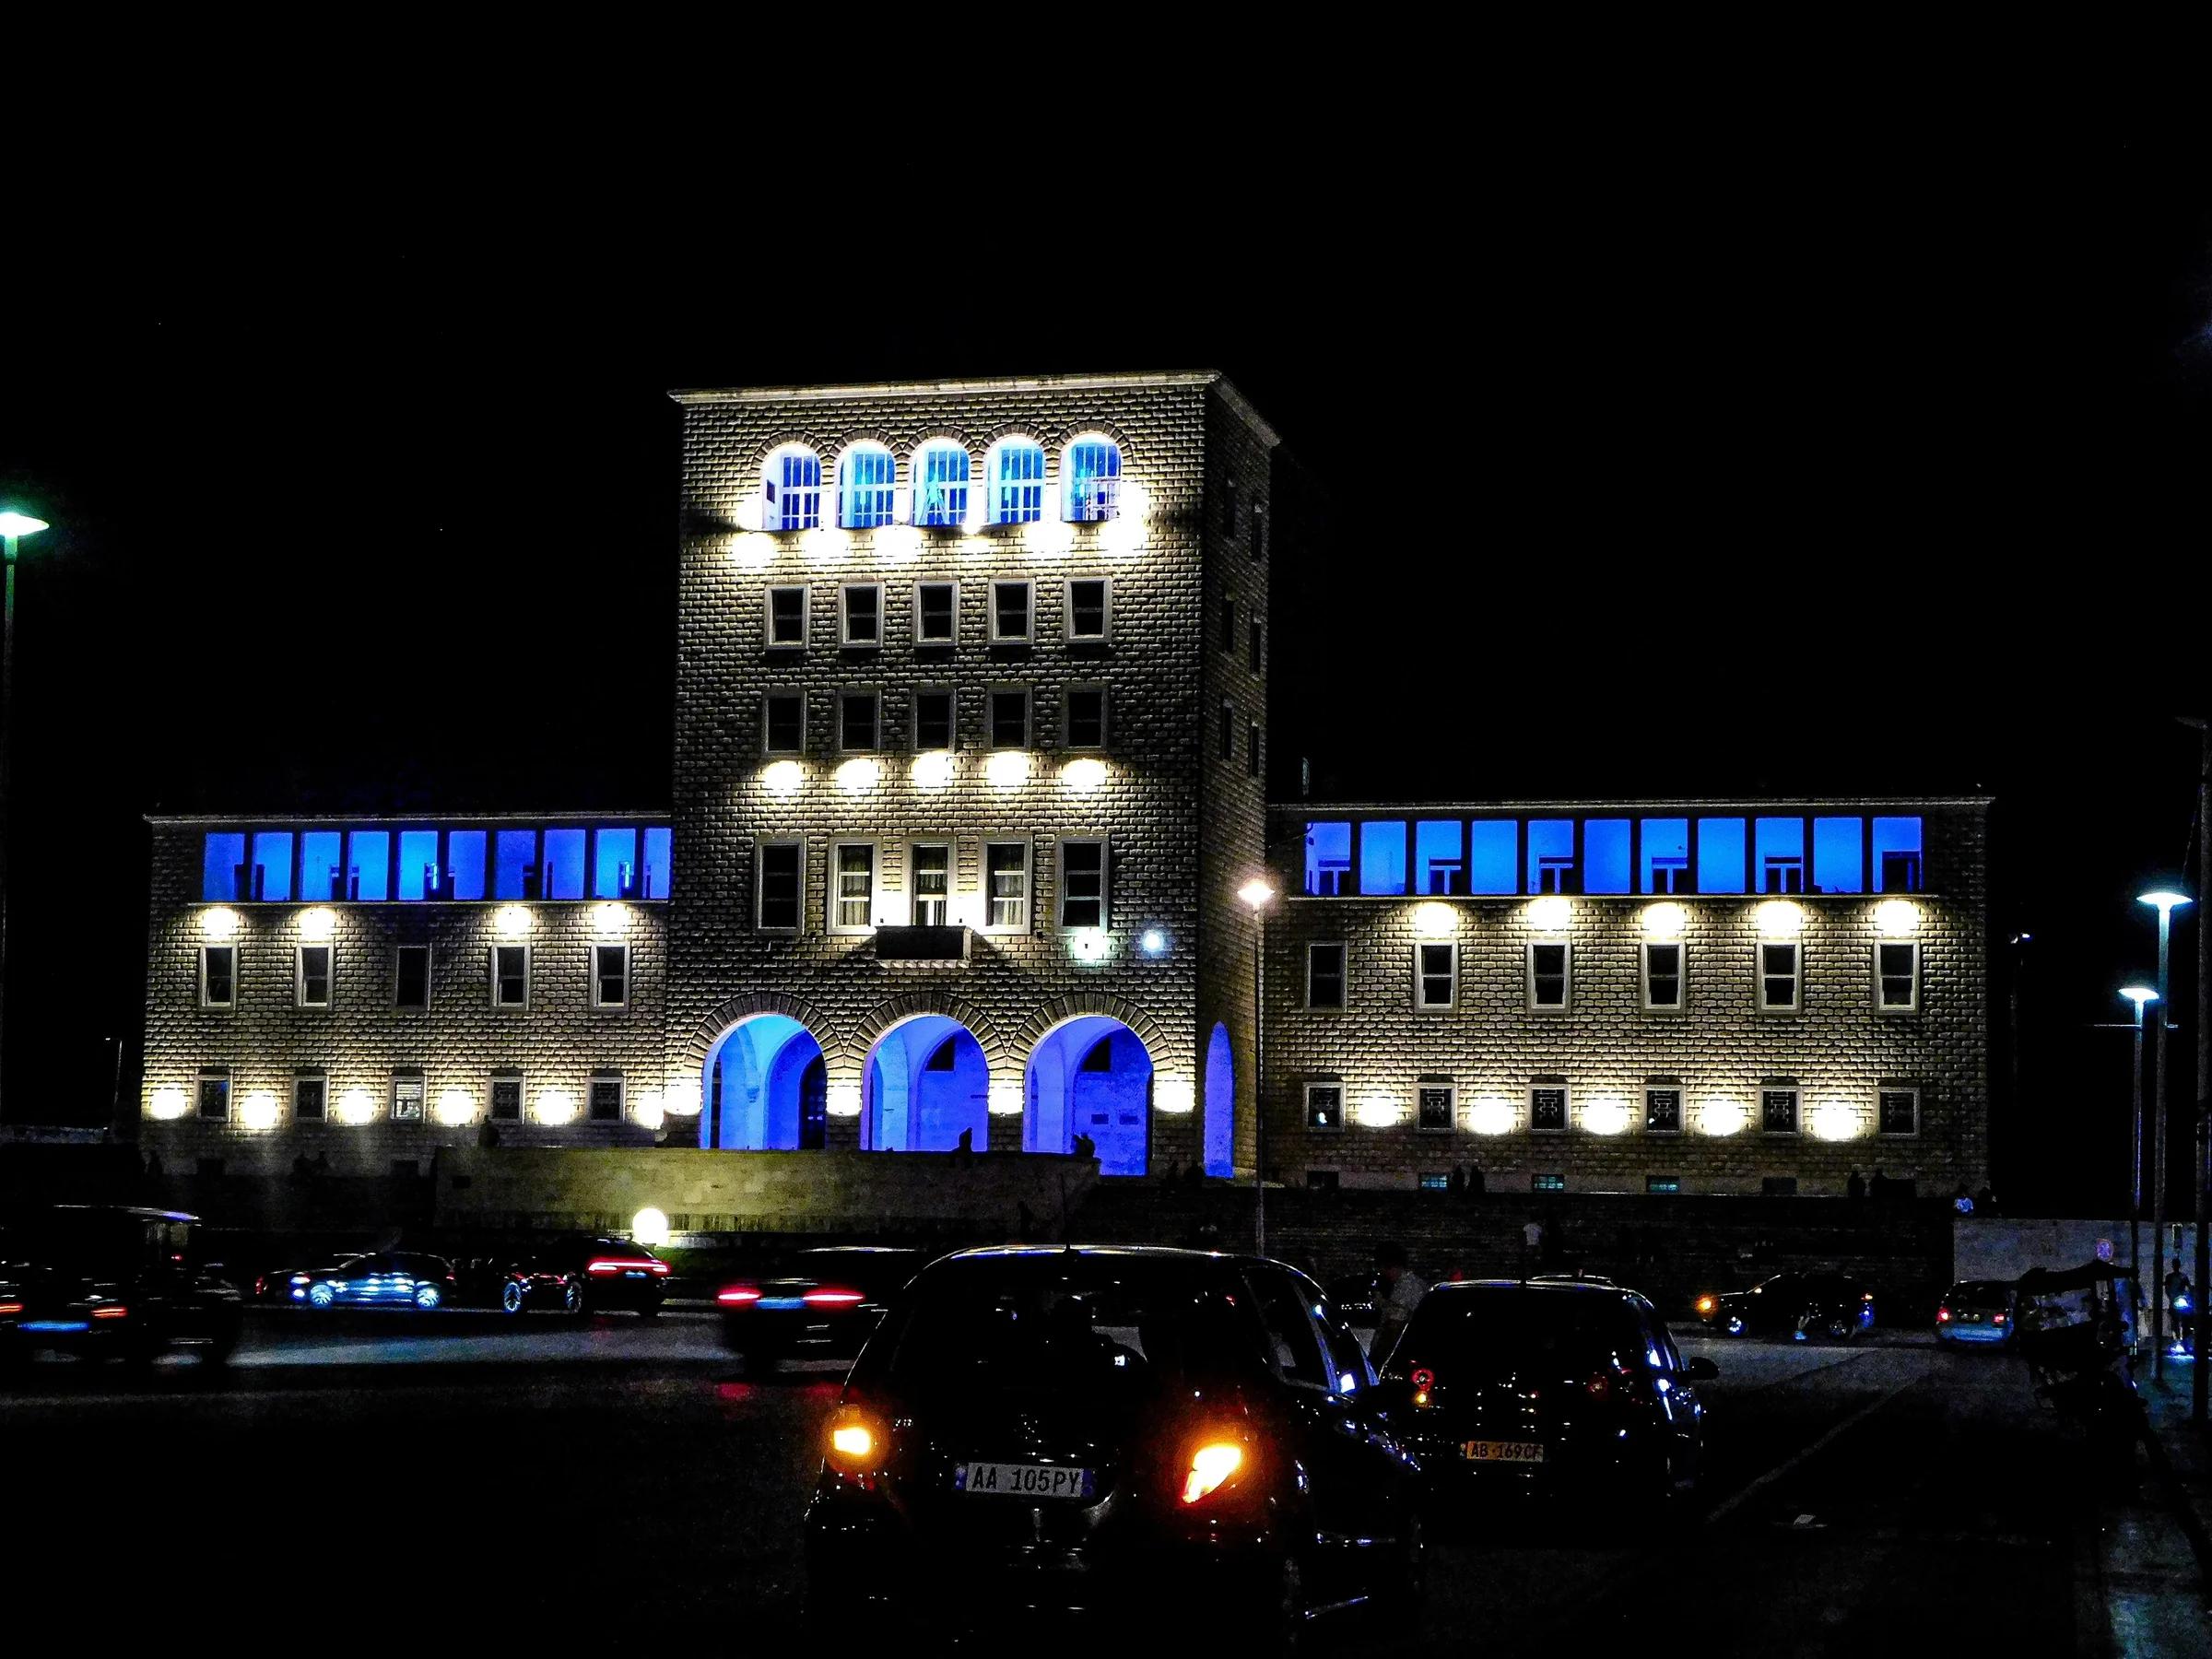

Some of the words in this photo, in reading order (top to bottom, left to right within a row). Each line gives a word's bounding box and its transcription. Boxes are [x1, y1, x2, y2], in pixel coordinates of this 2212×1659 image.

[1471, 1443, 1488, 1458] AB
[971, 1465, 997, 1489] AA
[1011, 1468, 1080, 1494] 105PY
